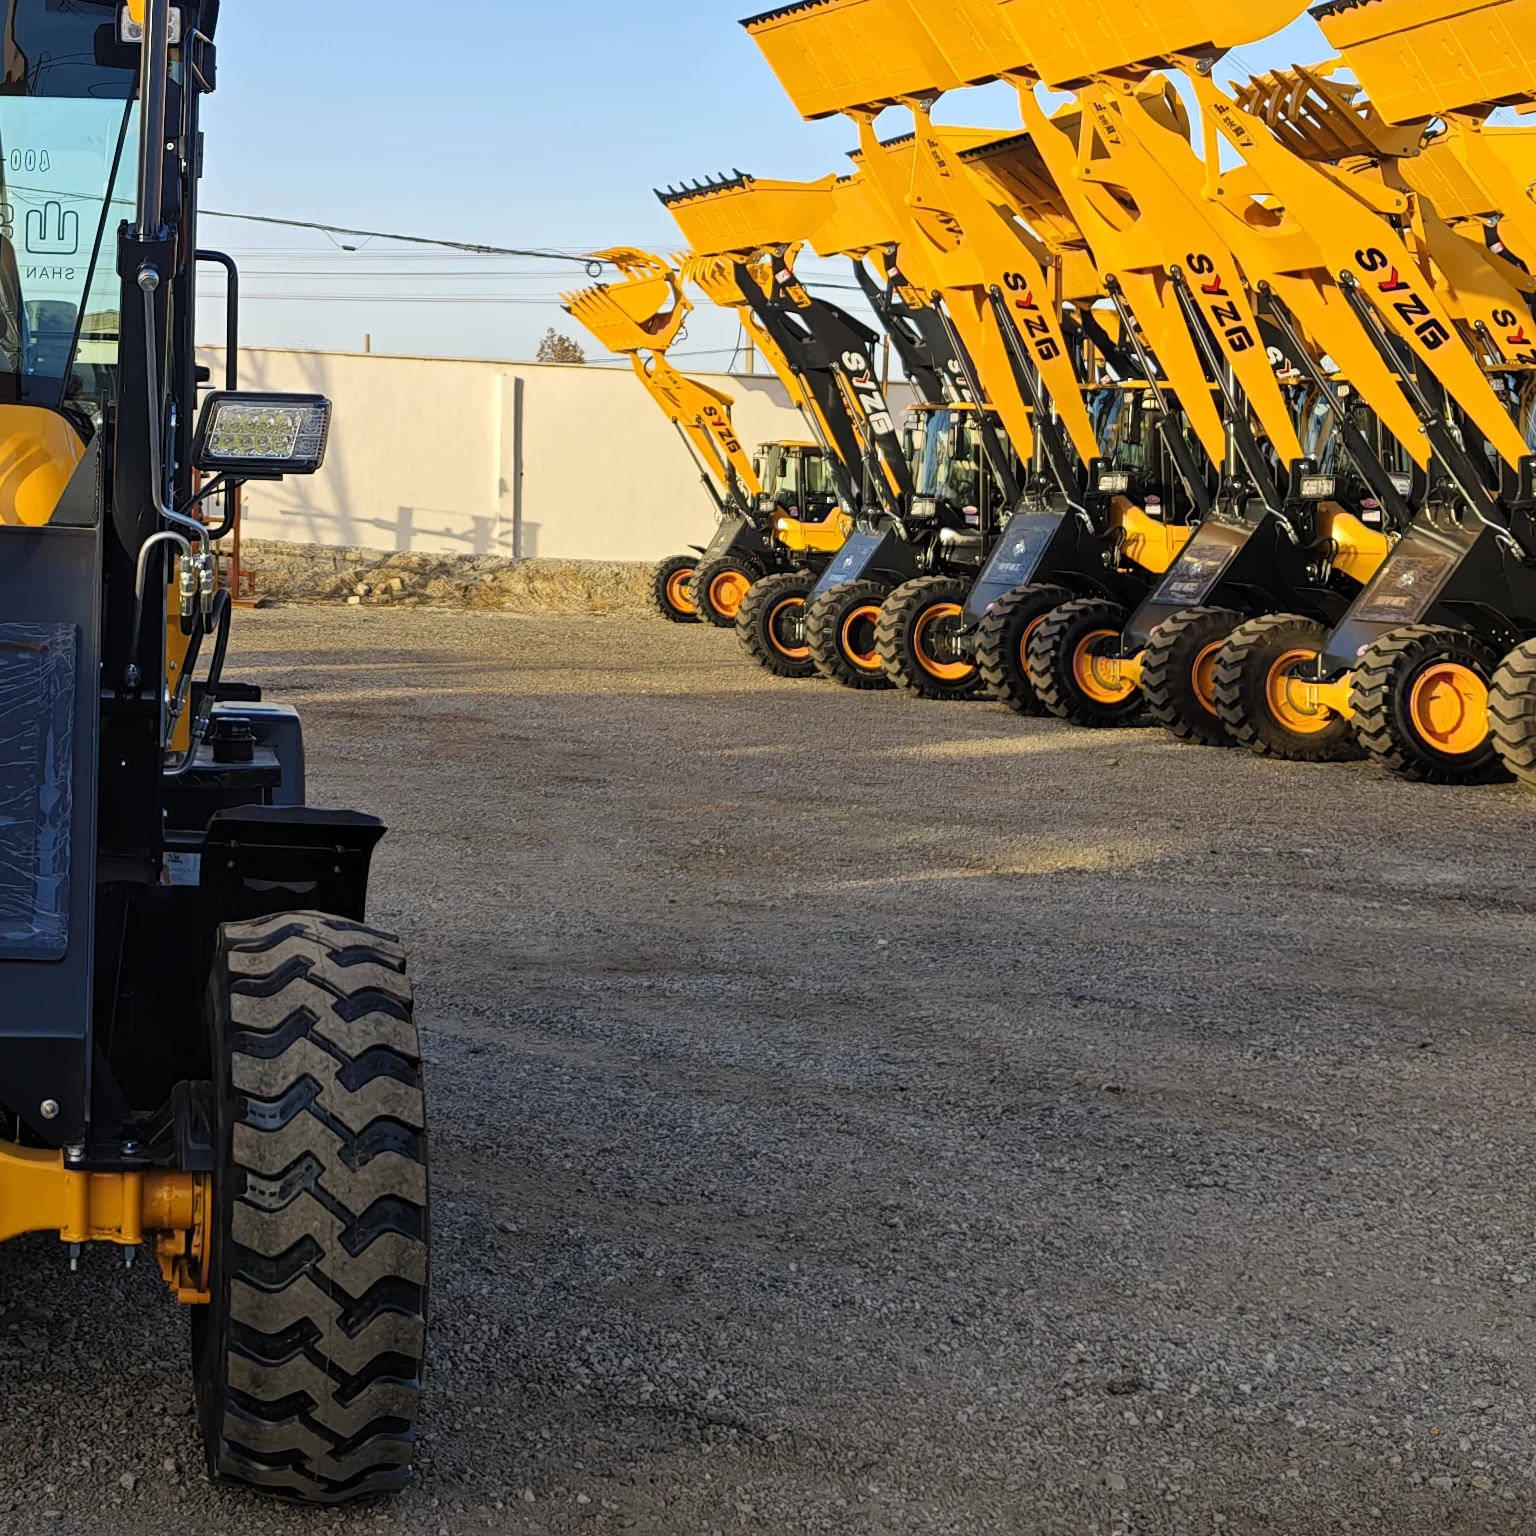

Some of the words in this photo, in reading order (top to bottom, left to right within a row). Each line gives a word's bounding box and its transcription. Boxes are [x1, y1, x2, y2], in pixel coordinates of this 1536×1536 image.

[1003, 271, 1061, 361] SYZG
[1186, 252, 1255, 352] SYZG
[1355, 247, 1451, 351] SYZG
[702, 405, 742, 454] SYZG
[841, 350, 894, 435] SYZG
